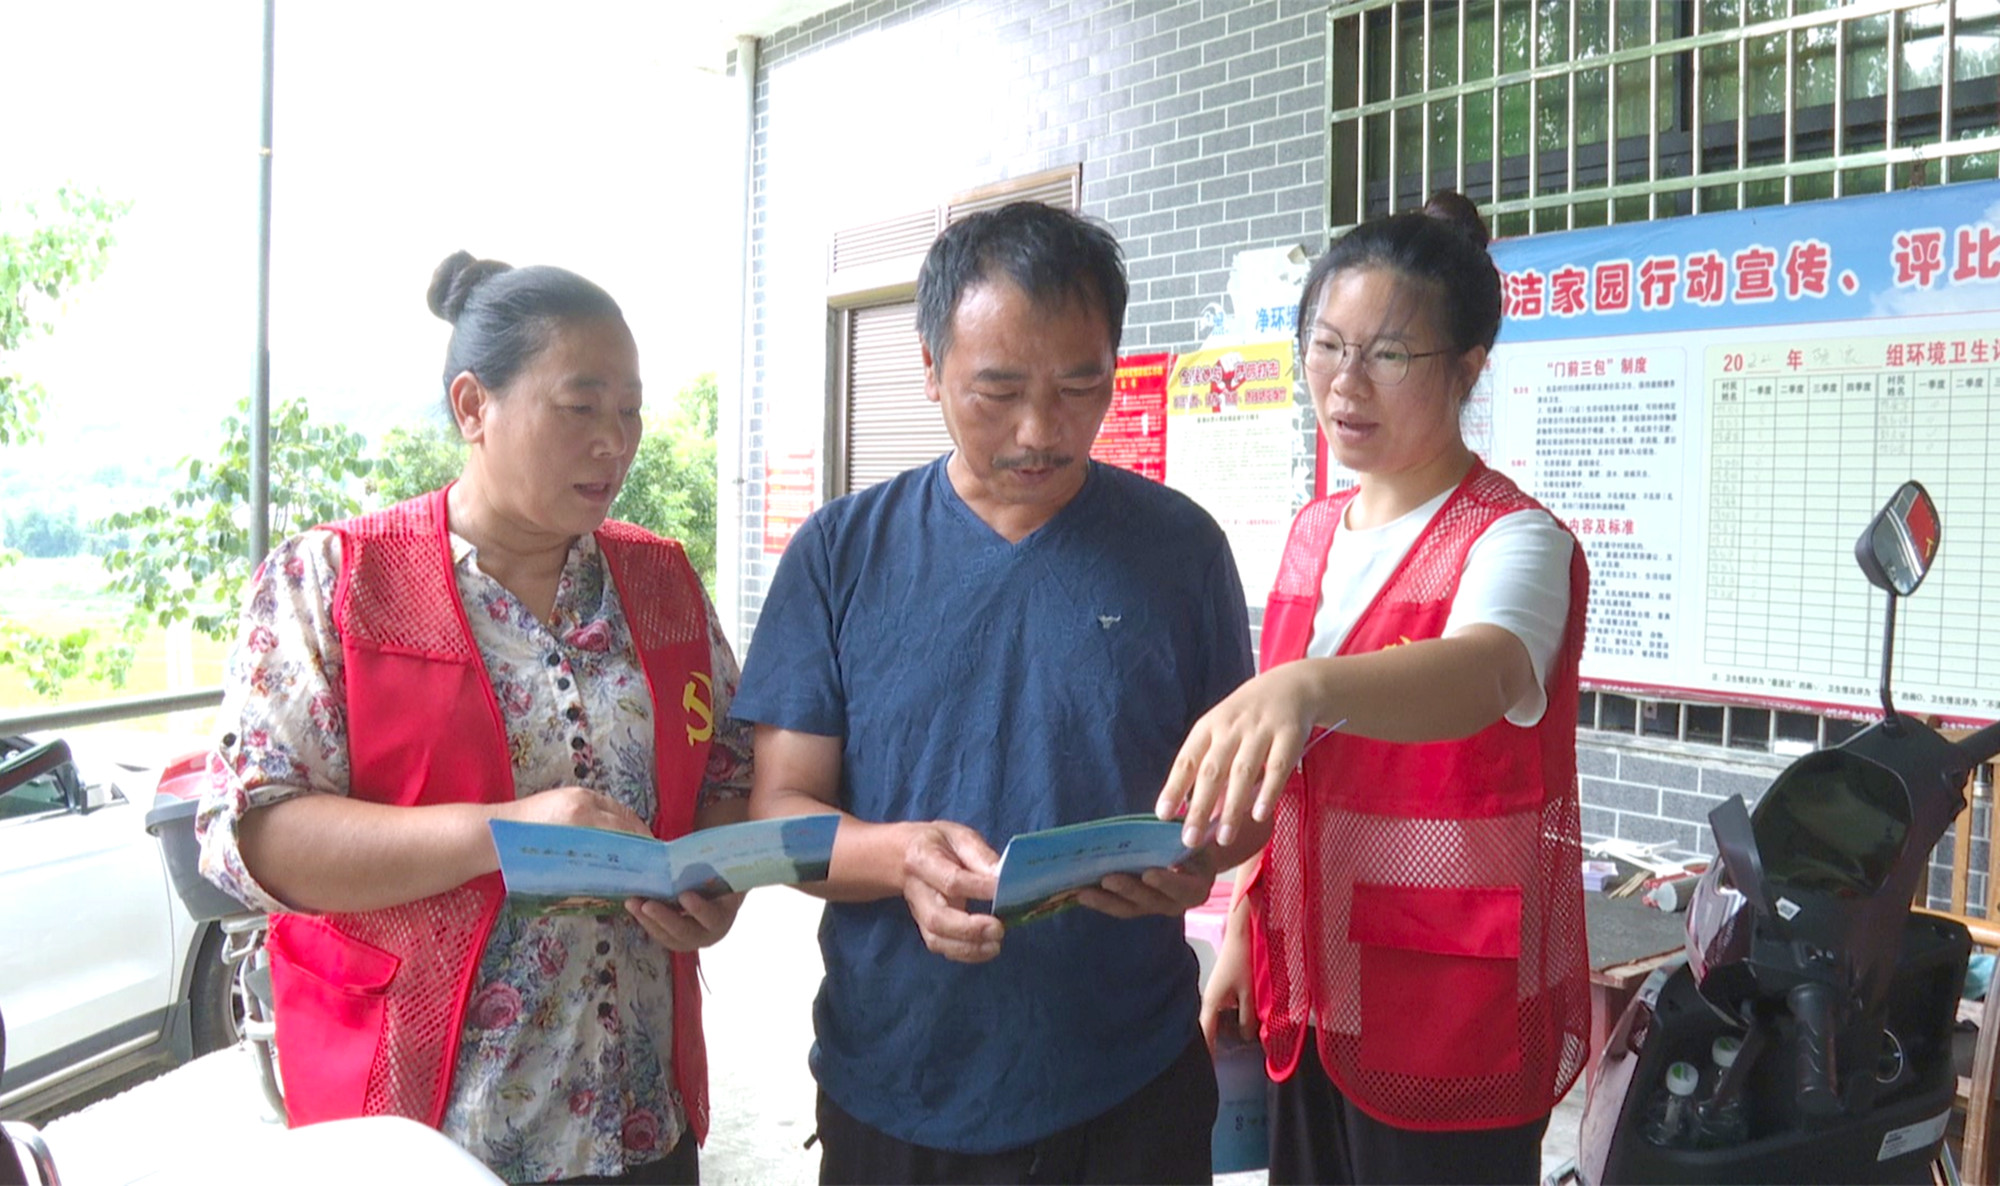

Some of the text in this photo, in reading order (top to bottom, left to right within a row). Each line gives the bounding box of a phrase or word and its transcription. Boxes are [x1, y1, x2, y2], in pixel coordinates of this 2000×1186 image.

[1501, 226, 2000, 317] 洁家园行动宣传、评比
[1562, 518, 1635, 535] 内容及标准
